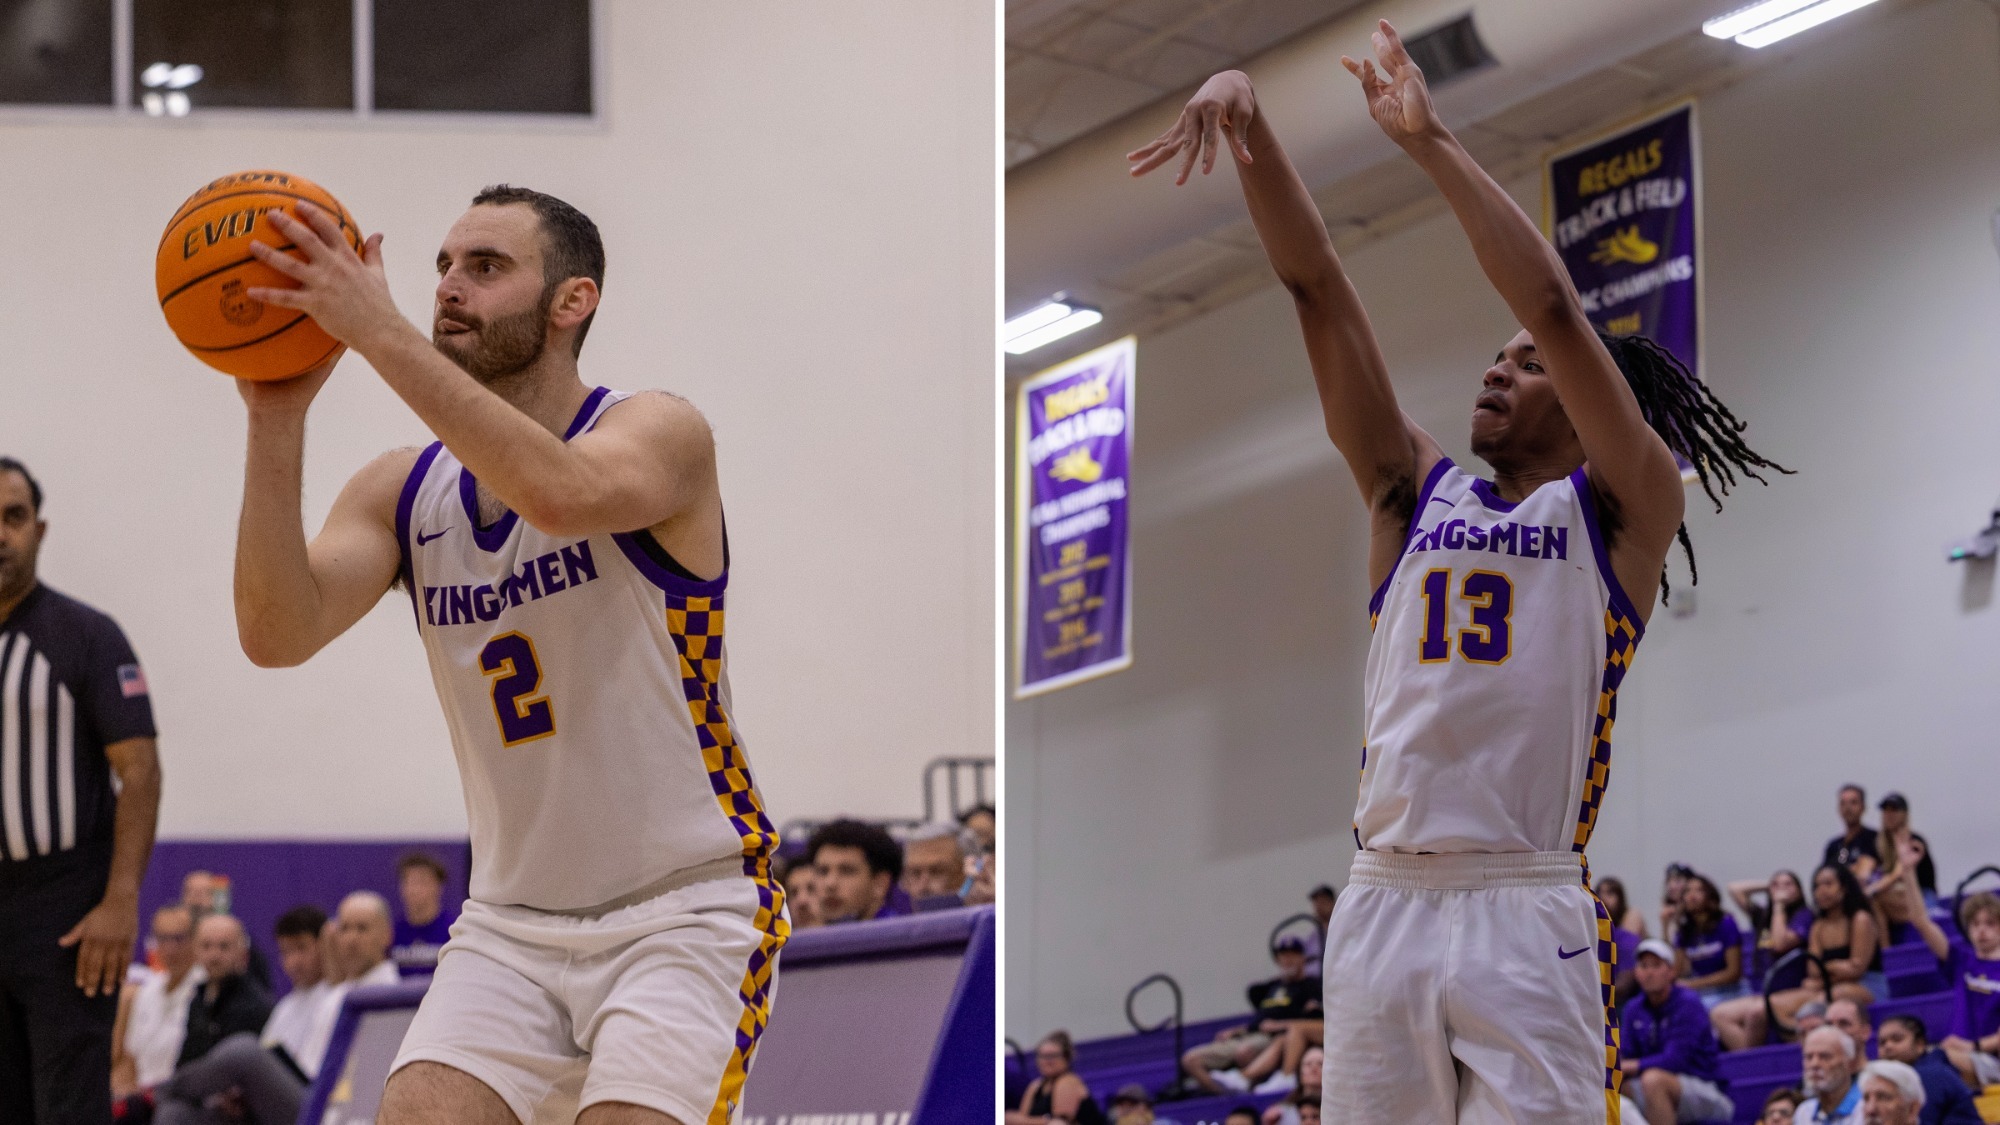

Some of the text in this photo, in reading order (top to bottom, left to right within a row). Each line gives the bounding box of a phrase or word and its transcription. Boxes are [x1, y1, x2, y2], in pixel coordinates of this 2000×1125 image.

[1578, 138, 1662, 197] REGALS
[183, 207, 257, 261] EVO
[1557, 176, 1686, 249] TRACK & FIELD
[1602, 254, 1693, 308] CHAMPIONS
[1407, 518, 1568, 561] NGSMEN
[1419, 567, 1514, 666] 13
[478, 630, 556, 748] 2
